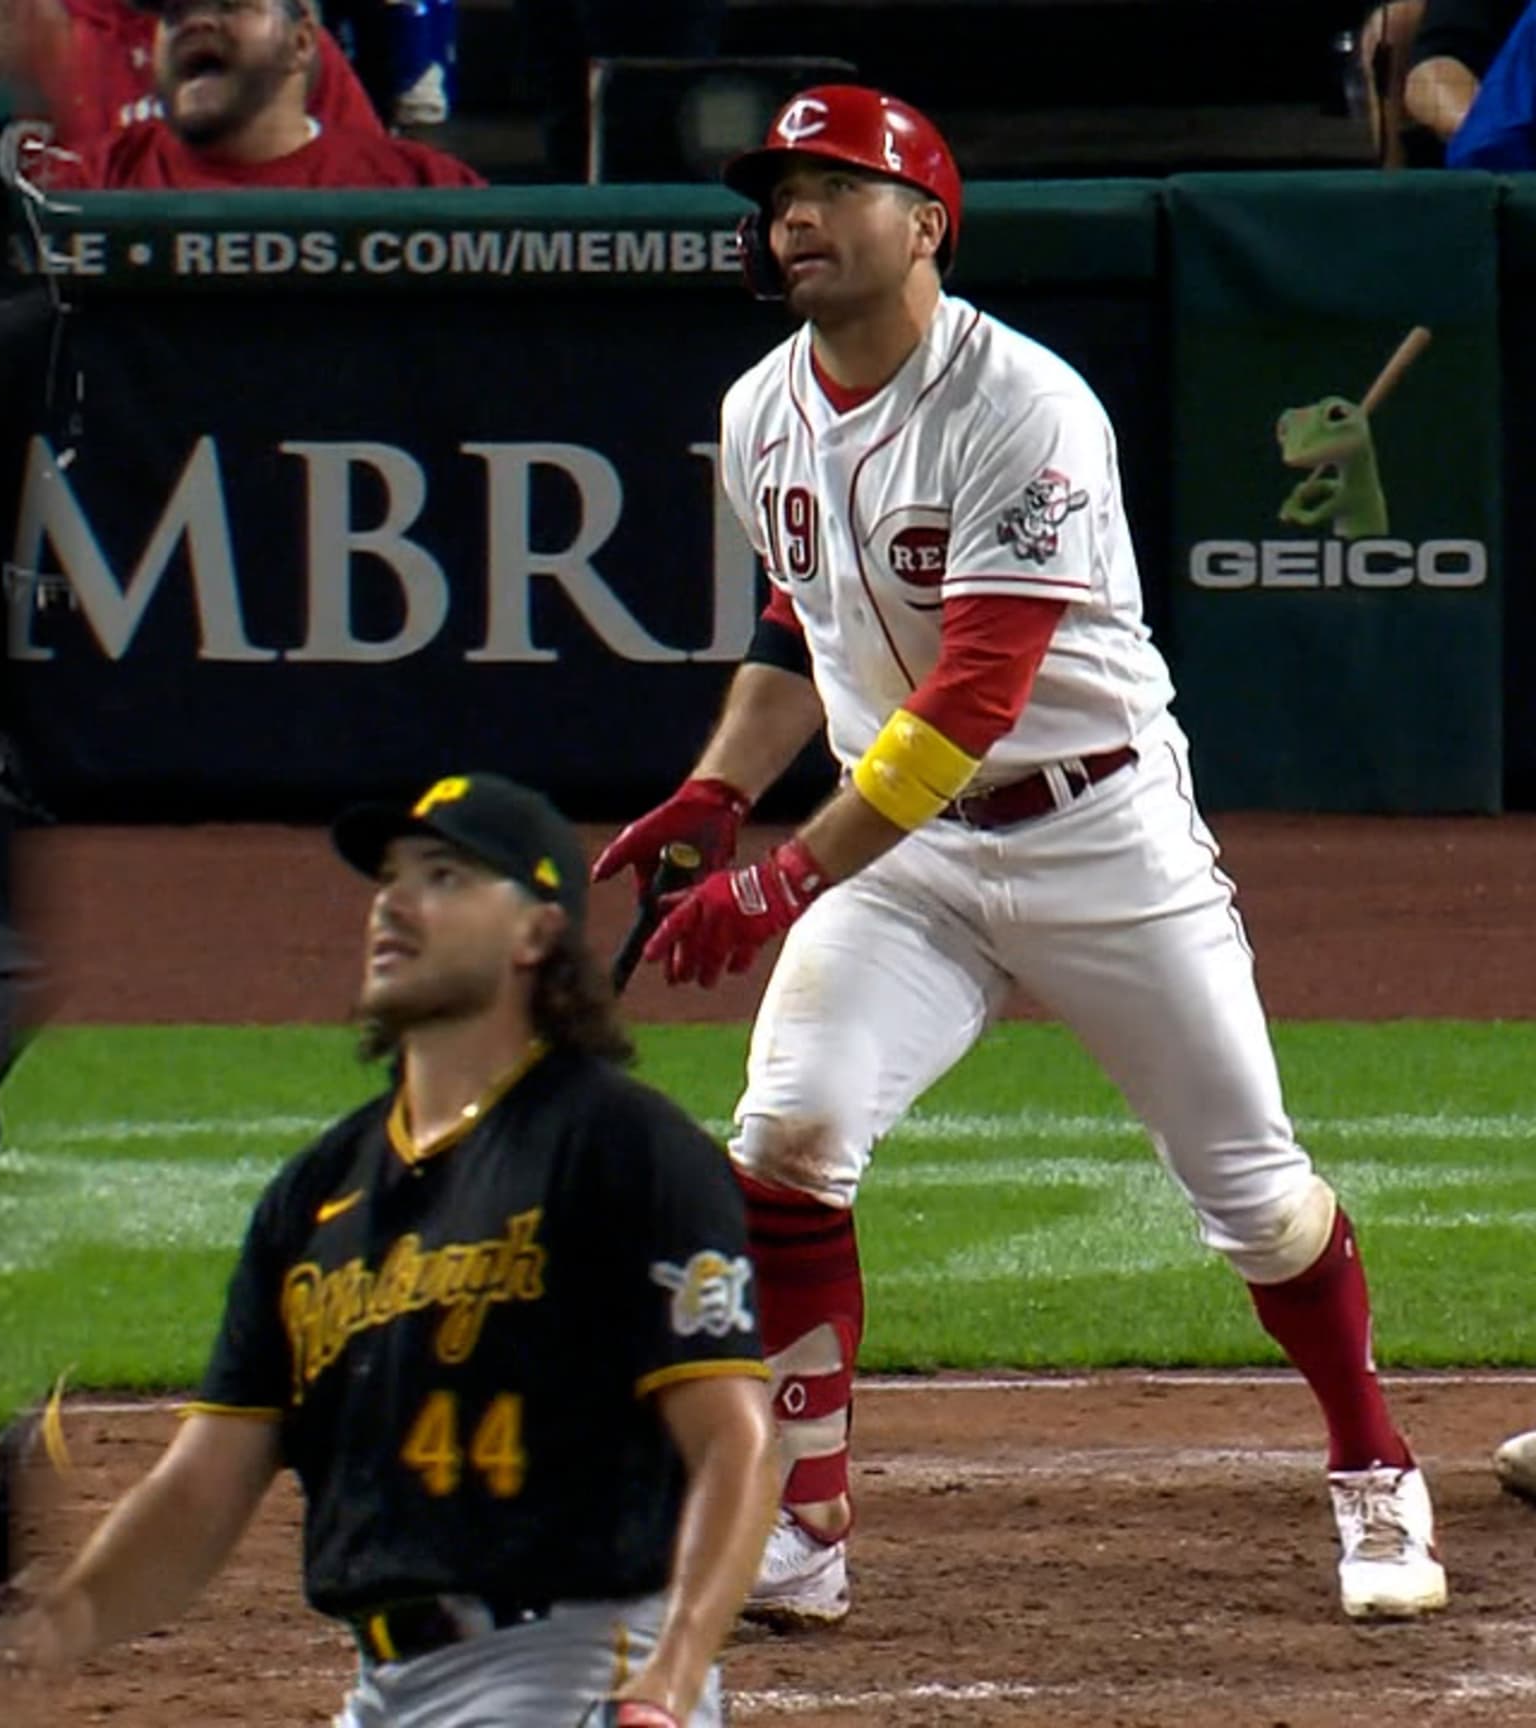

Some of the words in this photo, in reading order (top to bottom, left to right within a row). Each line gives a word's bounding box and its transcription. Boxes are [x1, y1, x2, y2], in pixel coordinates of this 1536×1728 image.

[761, 485, 819, 582] 19
[1189, 539, 1487, 588] GEICO
[412, 775, 470, 819] P
[400, 1390, 527, 1498] 44
